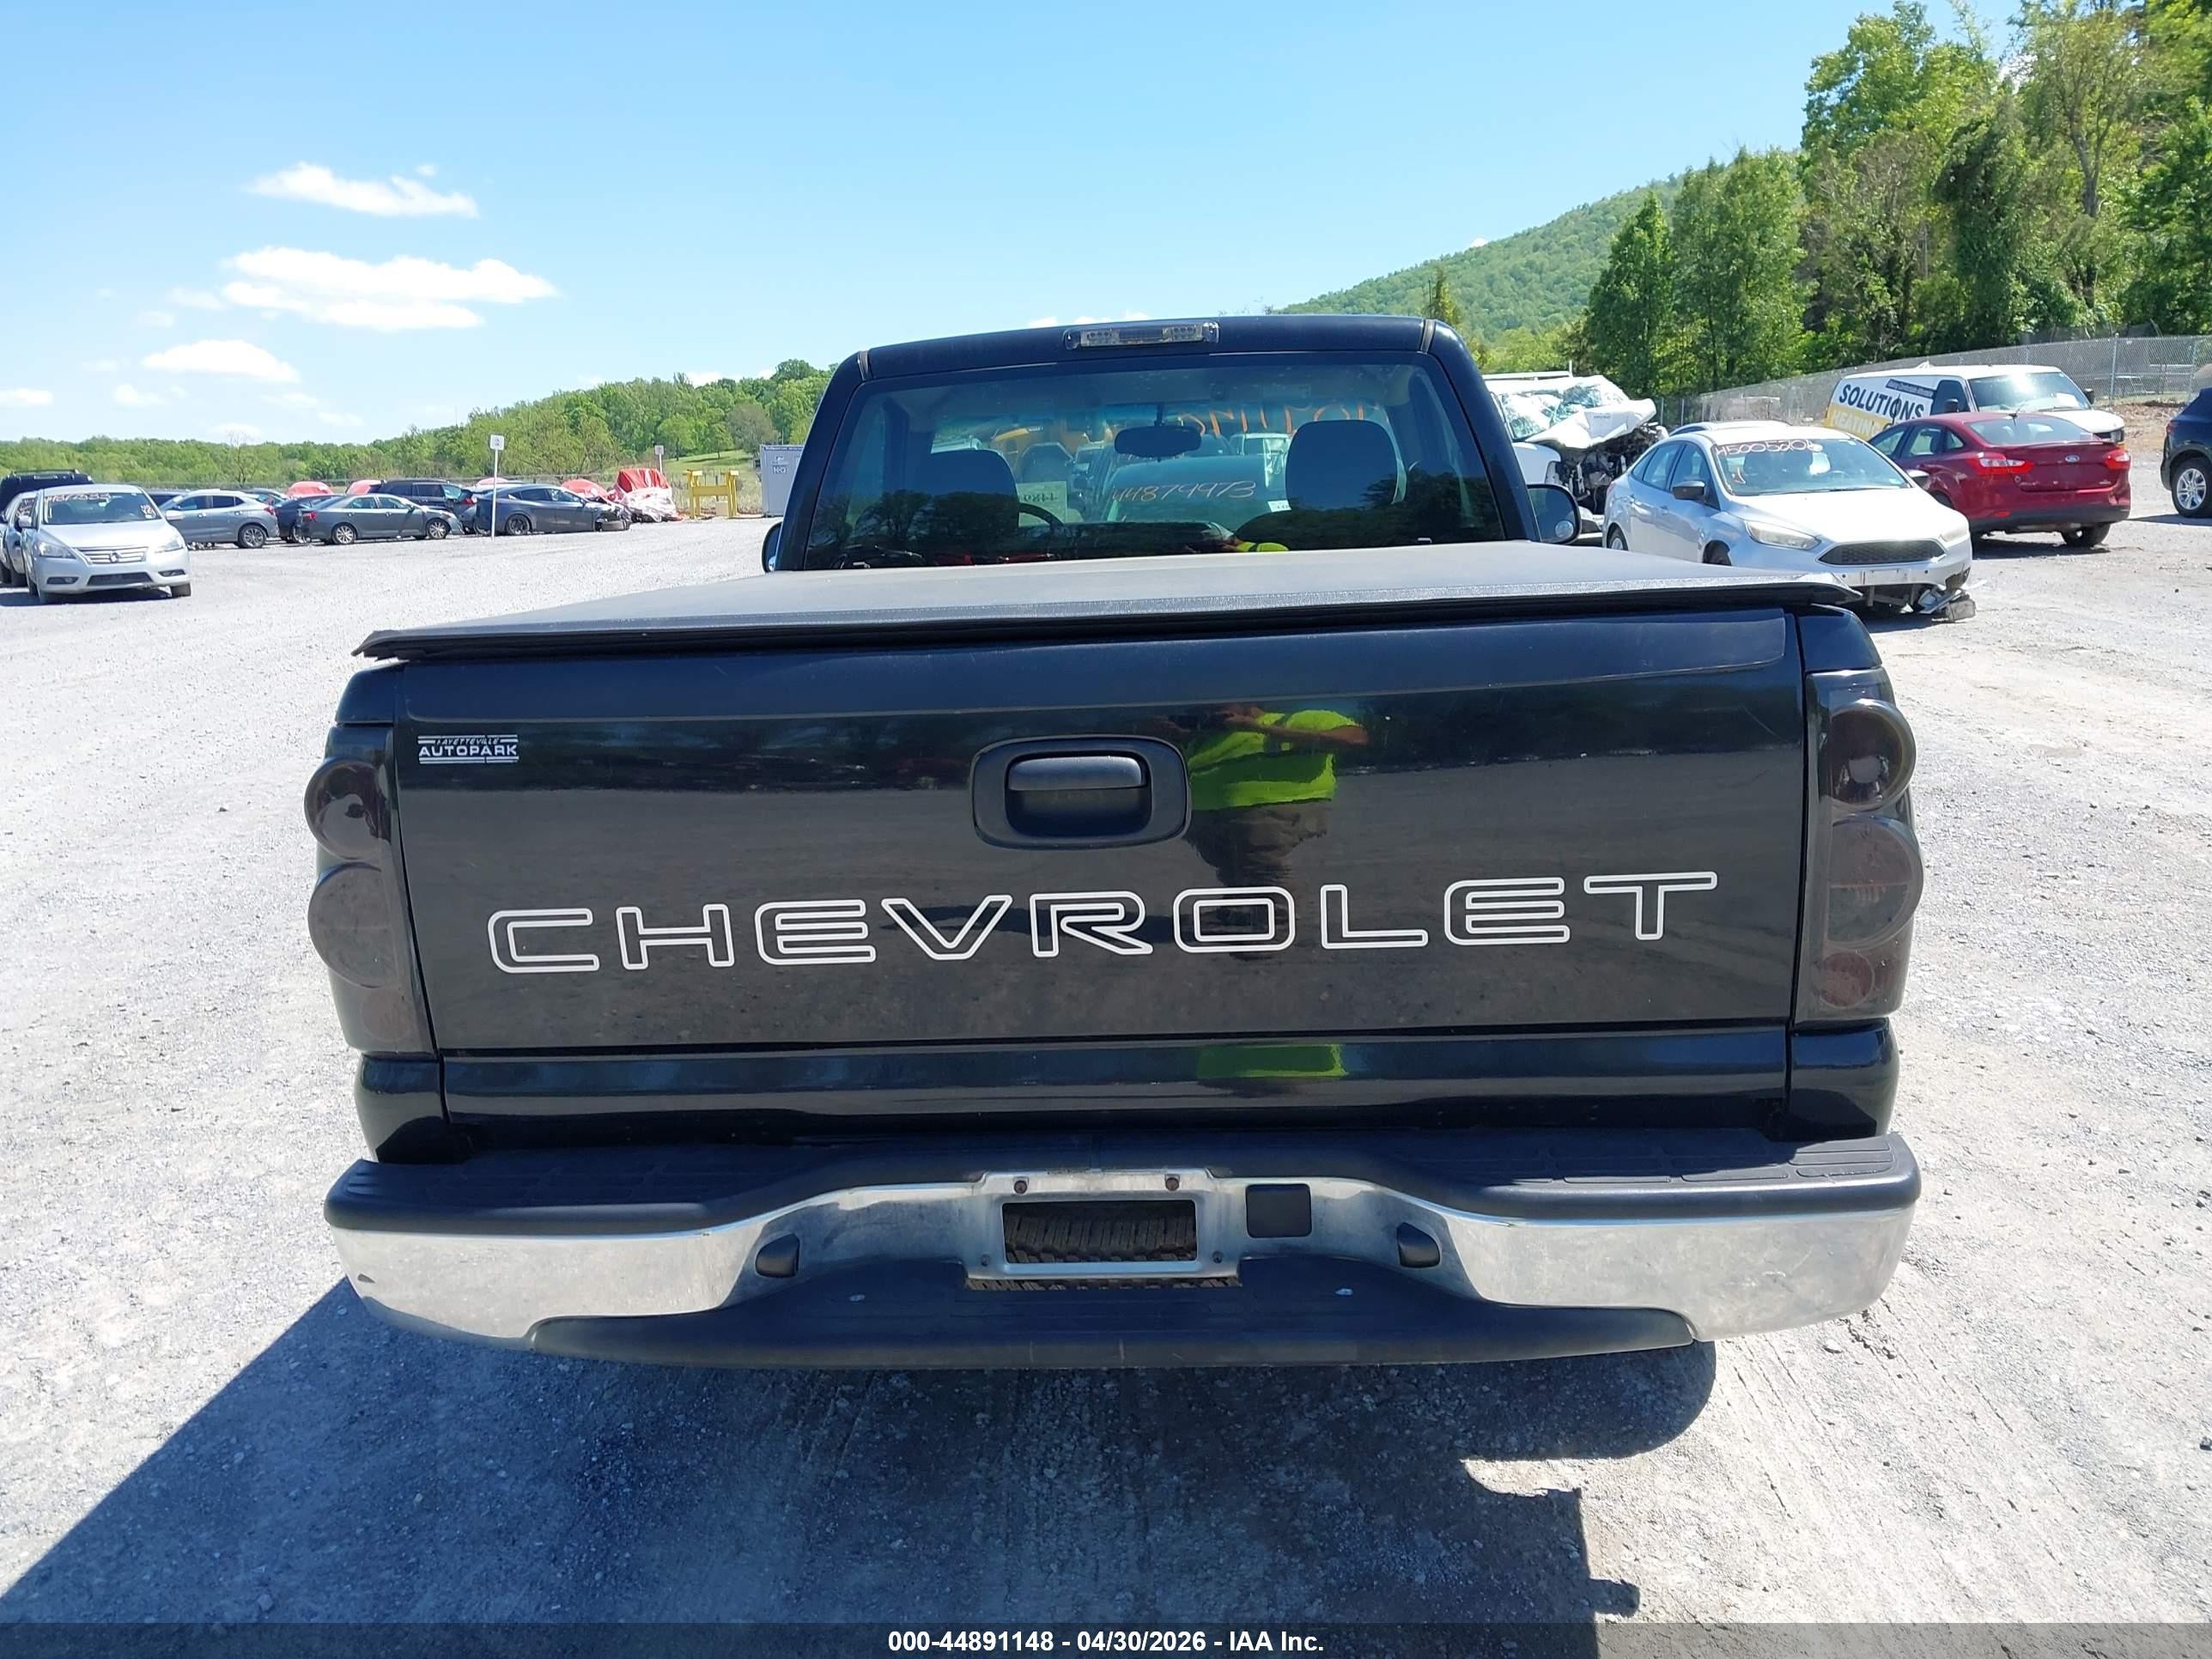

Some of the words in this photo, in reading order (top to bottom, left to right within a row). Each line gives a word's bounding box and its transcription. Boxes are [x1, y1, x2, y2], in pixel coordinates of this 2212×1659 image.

[1838, 384, 1924, 419] SOLUTIONS
[419, 745, 517, 757] AUTOPARK
[488, 872, 1717, 973] CHEVROLET
